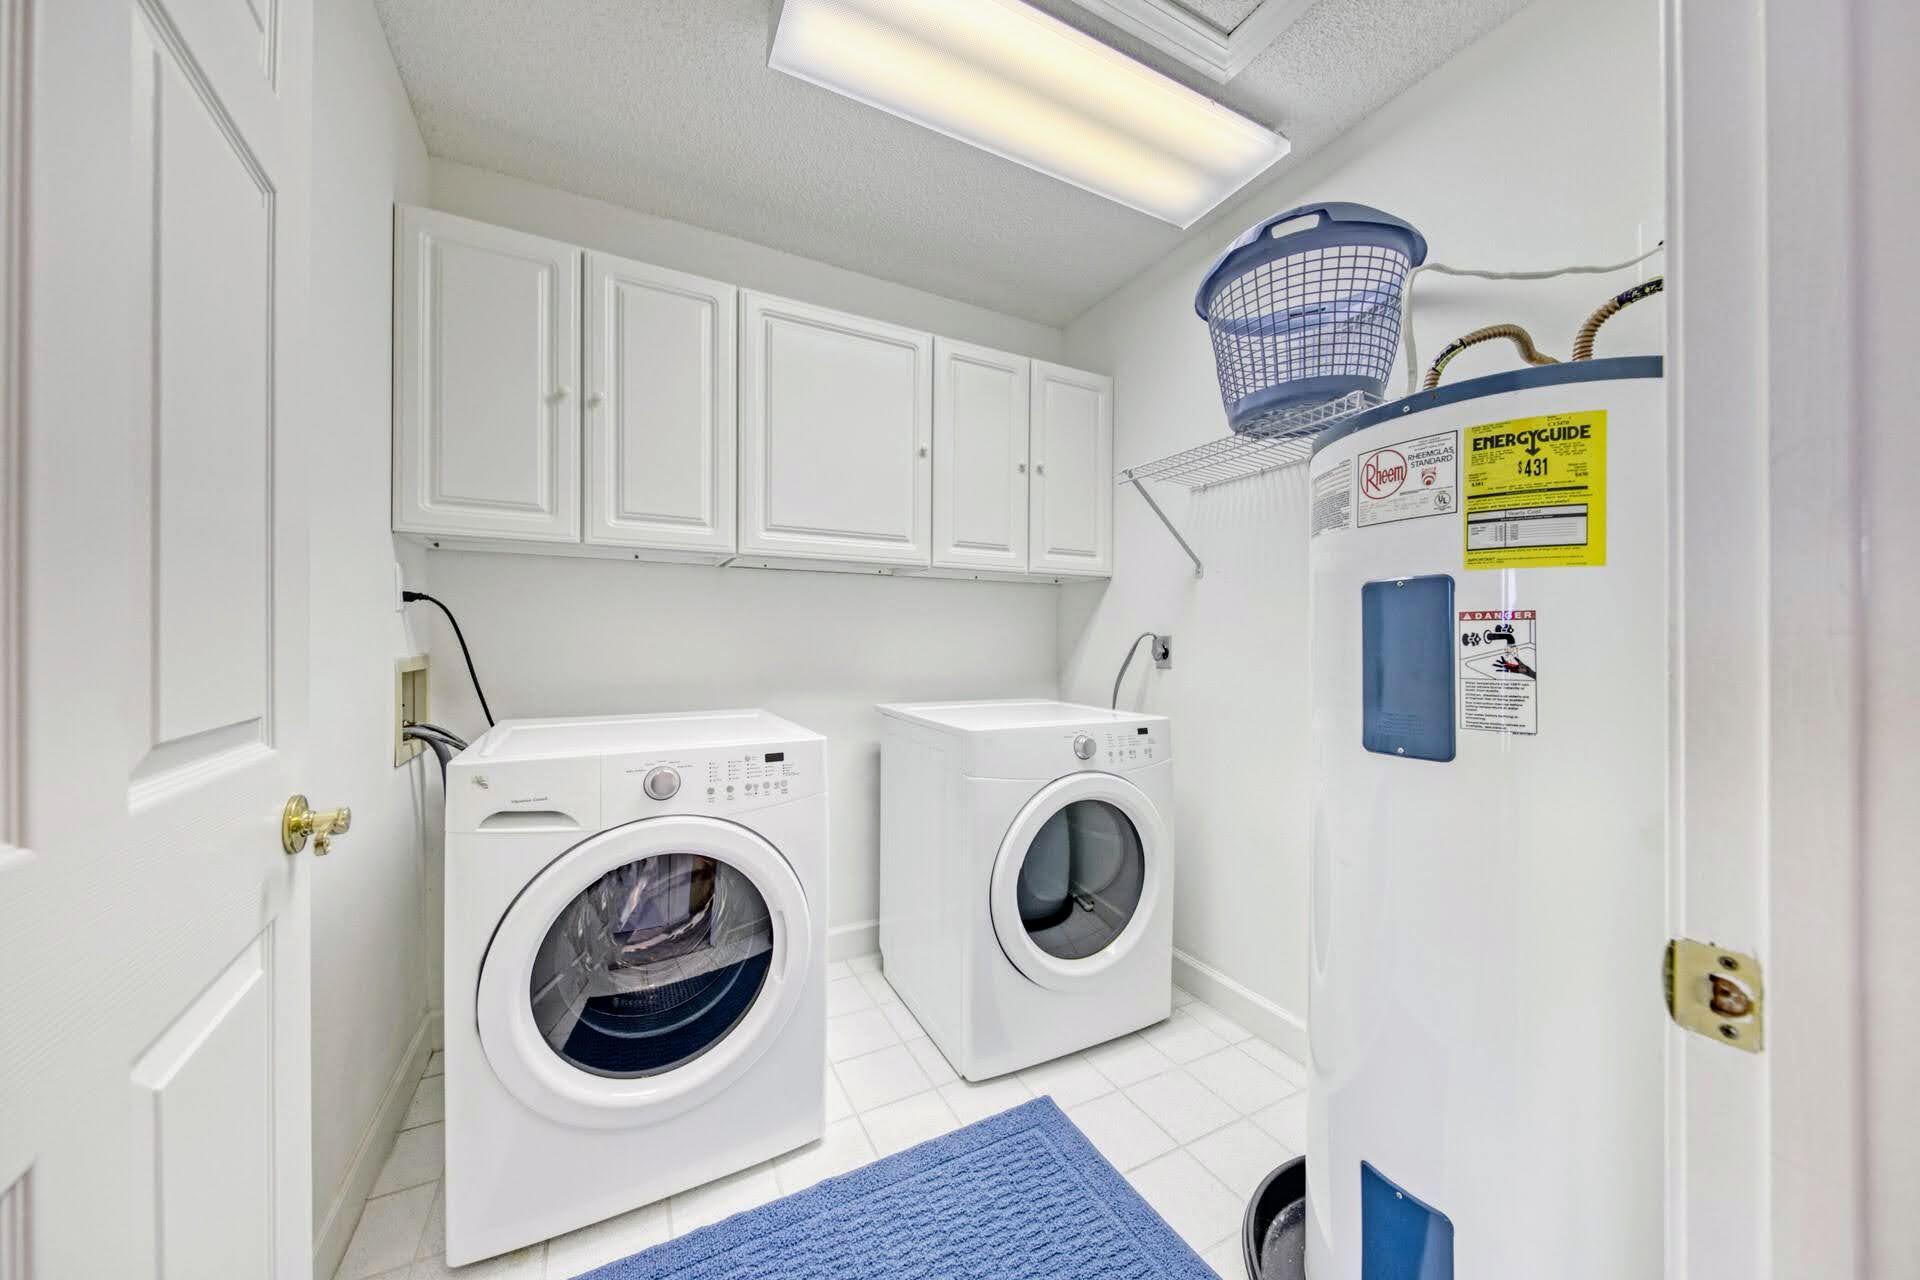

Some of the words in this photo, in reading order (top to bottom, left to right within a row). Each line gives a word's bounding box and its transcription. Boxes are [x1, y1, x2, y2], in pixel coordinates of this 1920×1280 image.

[1472, 424, 1591, 453] ENERGYGUIDE
[1410, 454, 1453, 468] STANDARD
[1518, 457, 1548, 477] $431
[1366, 455, 1405, 493] Rheem
[1475, 611, 1533, 620] DANGER
